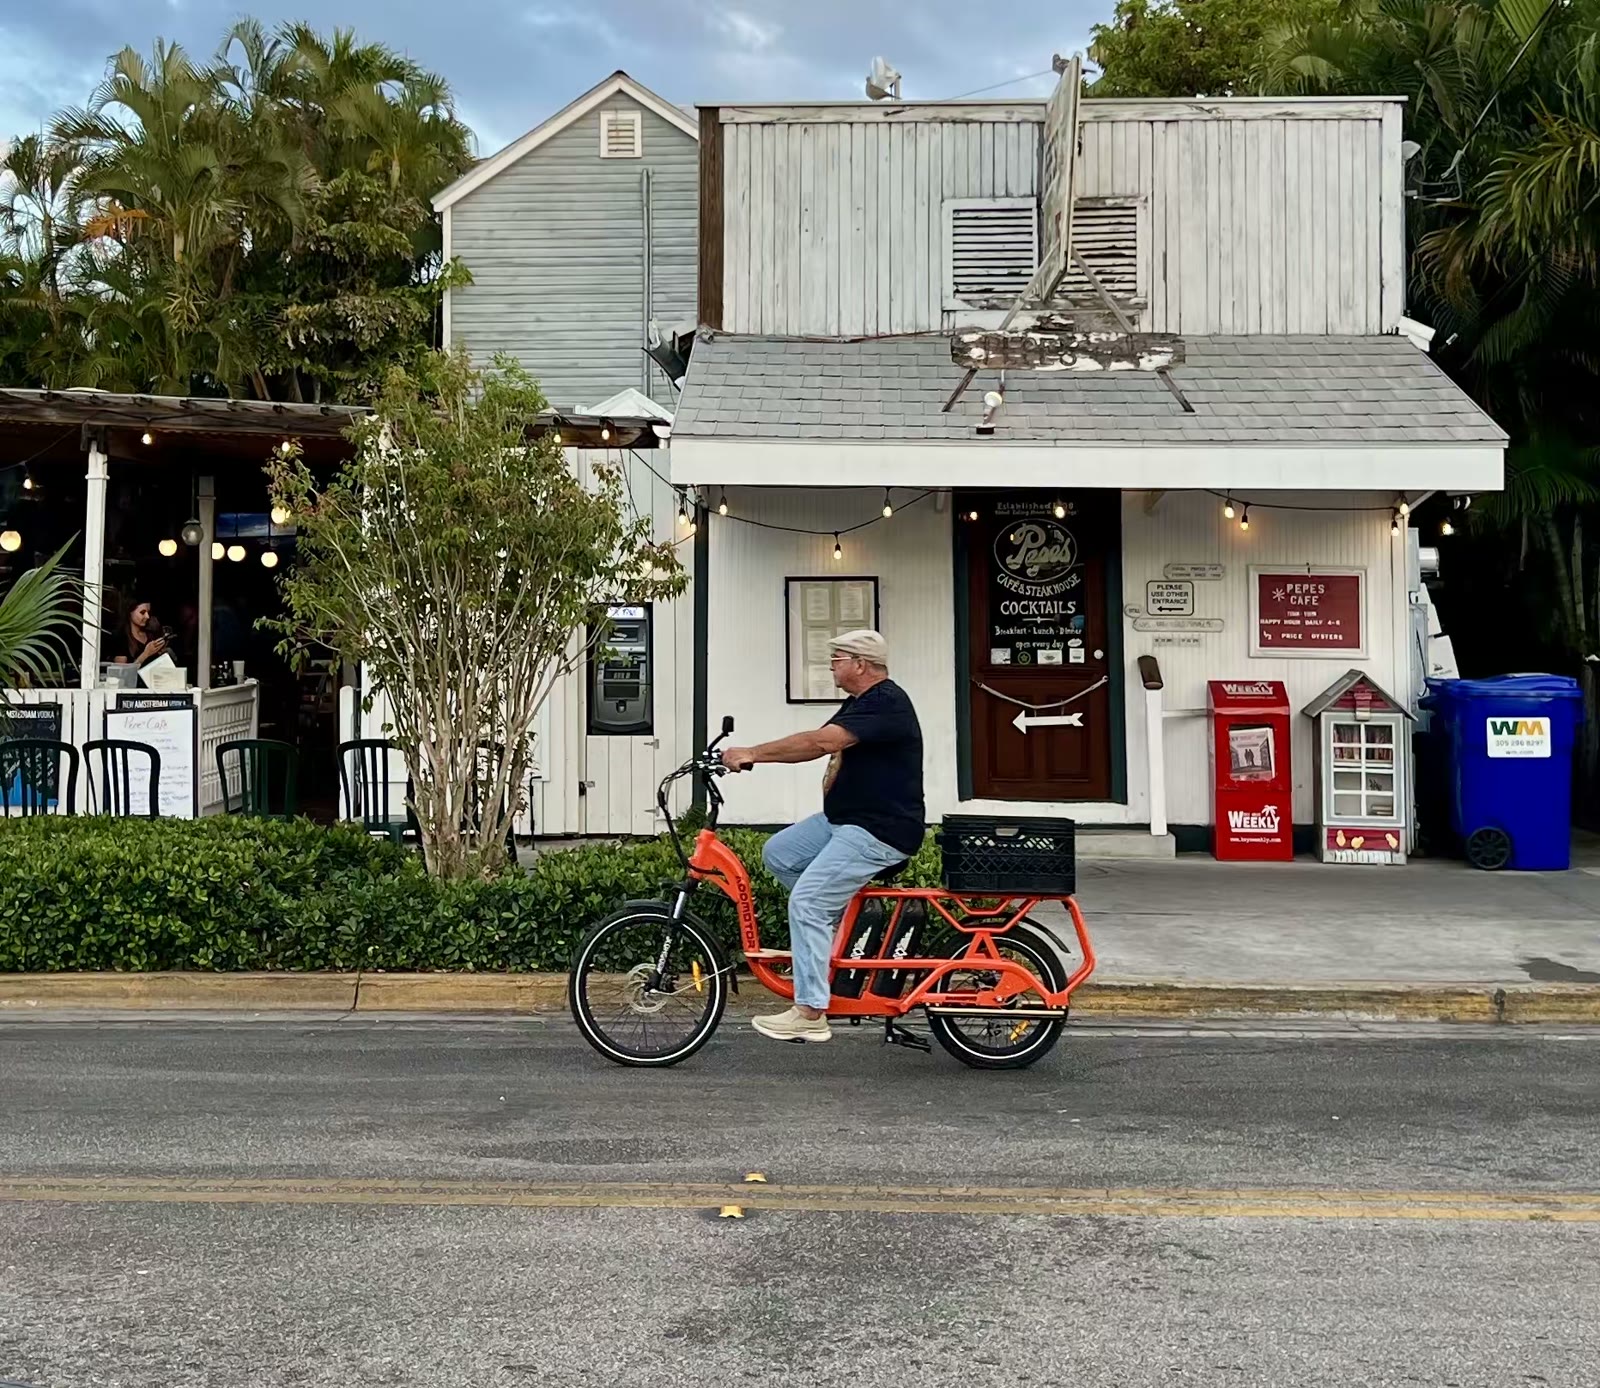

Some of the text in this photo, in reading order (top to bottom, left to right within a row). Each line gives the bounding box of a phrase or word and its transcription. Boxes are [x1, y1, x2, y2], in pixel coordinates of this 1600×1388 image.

[1286, 583, 1325, 594] PEPES
[1290, 595, 1319, 605] CAFE
[1000, 600, 1076, 615] COCKTAILS
[994, 625, 1082, 636] Breakfast Lunch Dinner
[1015, 639, 1064, 650] open every day
[135, 700, 168, 708] AMSTERDAM
[37, 710, 54, 718] VODKA
[1490, 721, 1544, 735] WM
[1228, 811, 1280, 829] WEEKLY
